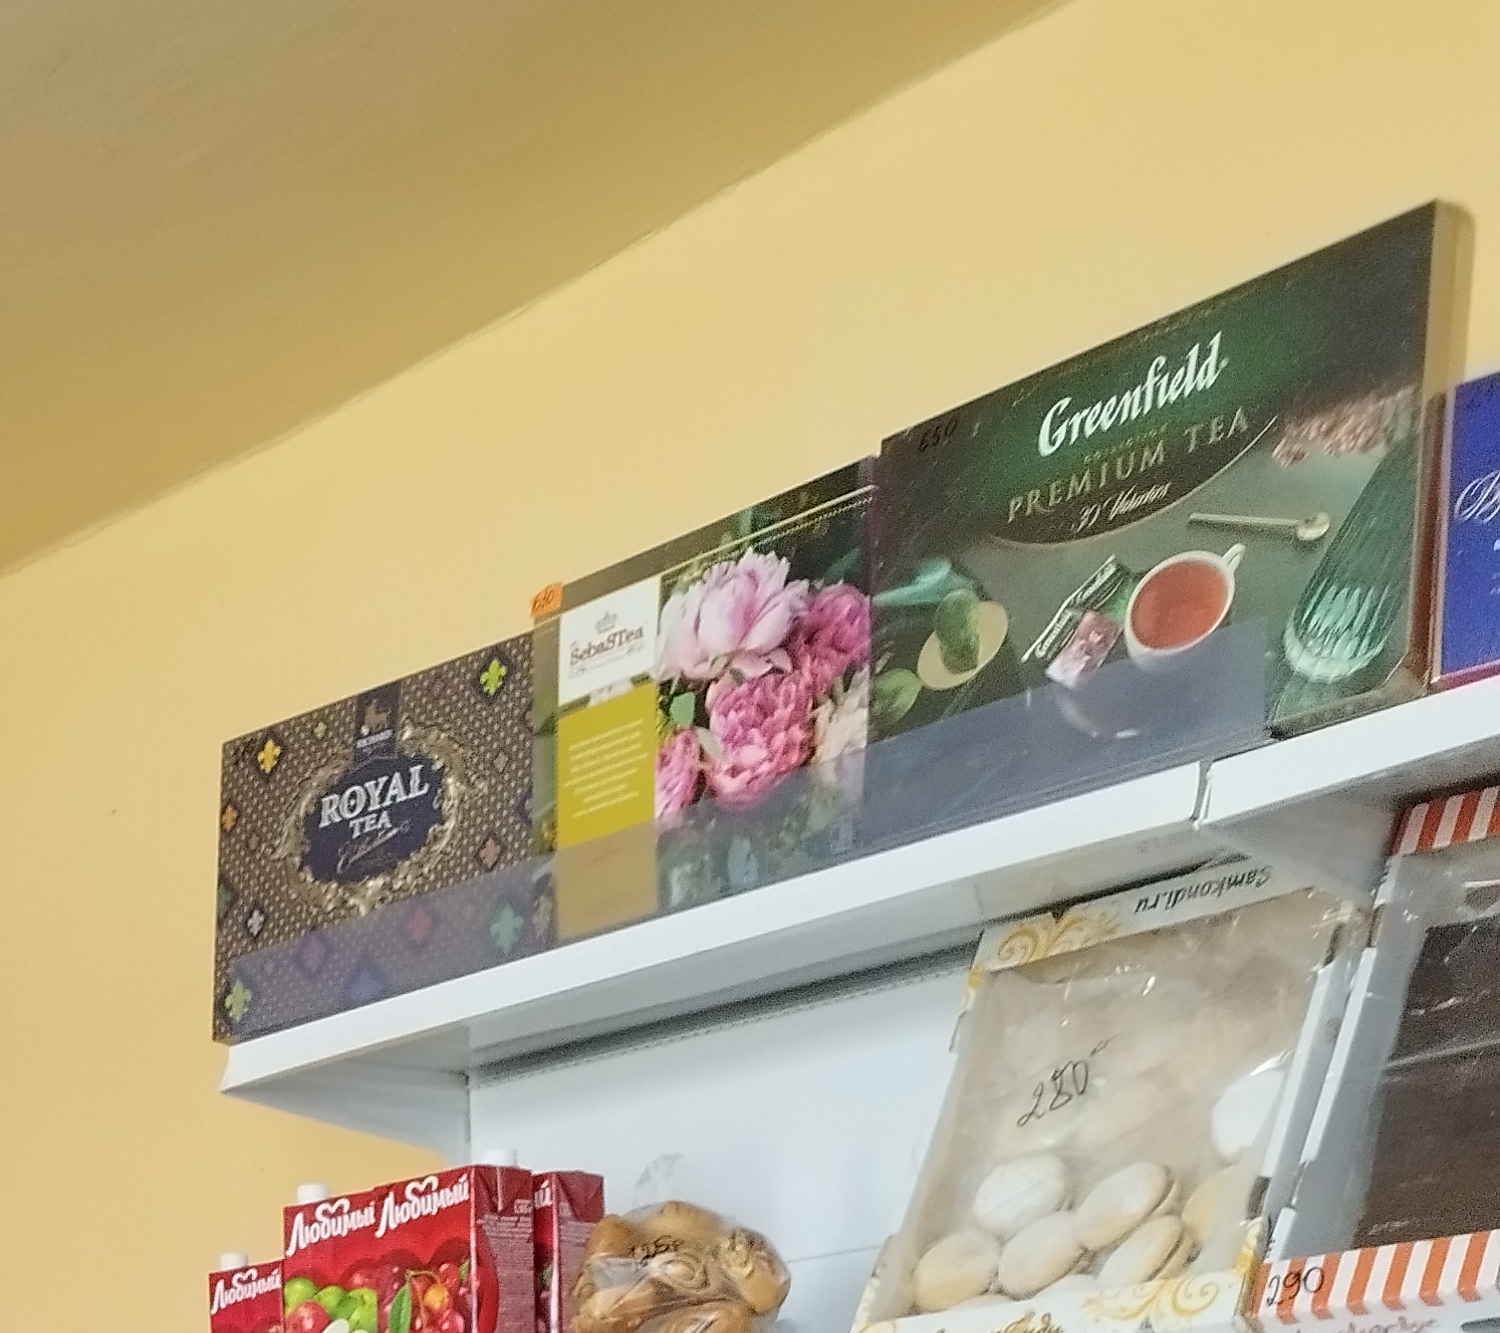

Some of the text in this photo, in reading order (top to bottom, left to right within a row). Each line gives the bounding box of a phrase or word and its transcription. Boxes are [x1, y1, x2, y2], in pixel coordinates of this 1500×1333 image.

[1038, 330, 1230, 457] Greenfield
[1007, 440, 1166, 524] PREMIUM
[1185, 406, 1249, 453] TEA
[319, 764, 430, 829] ROYAL
[349, 810, 392, 839] TEA
[285, 1198, 376, 1257] Любимый
[374, 1174, 471, 1239] Любимый
[210, 1267, 283, 1316] Любимый
[1266, 1265, 1325, 1307] 290
